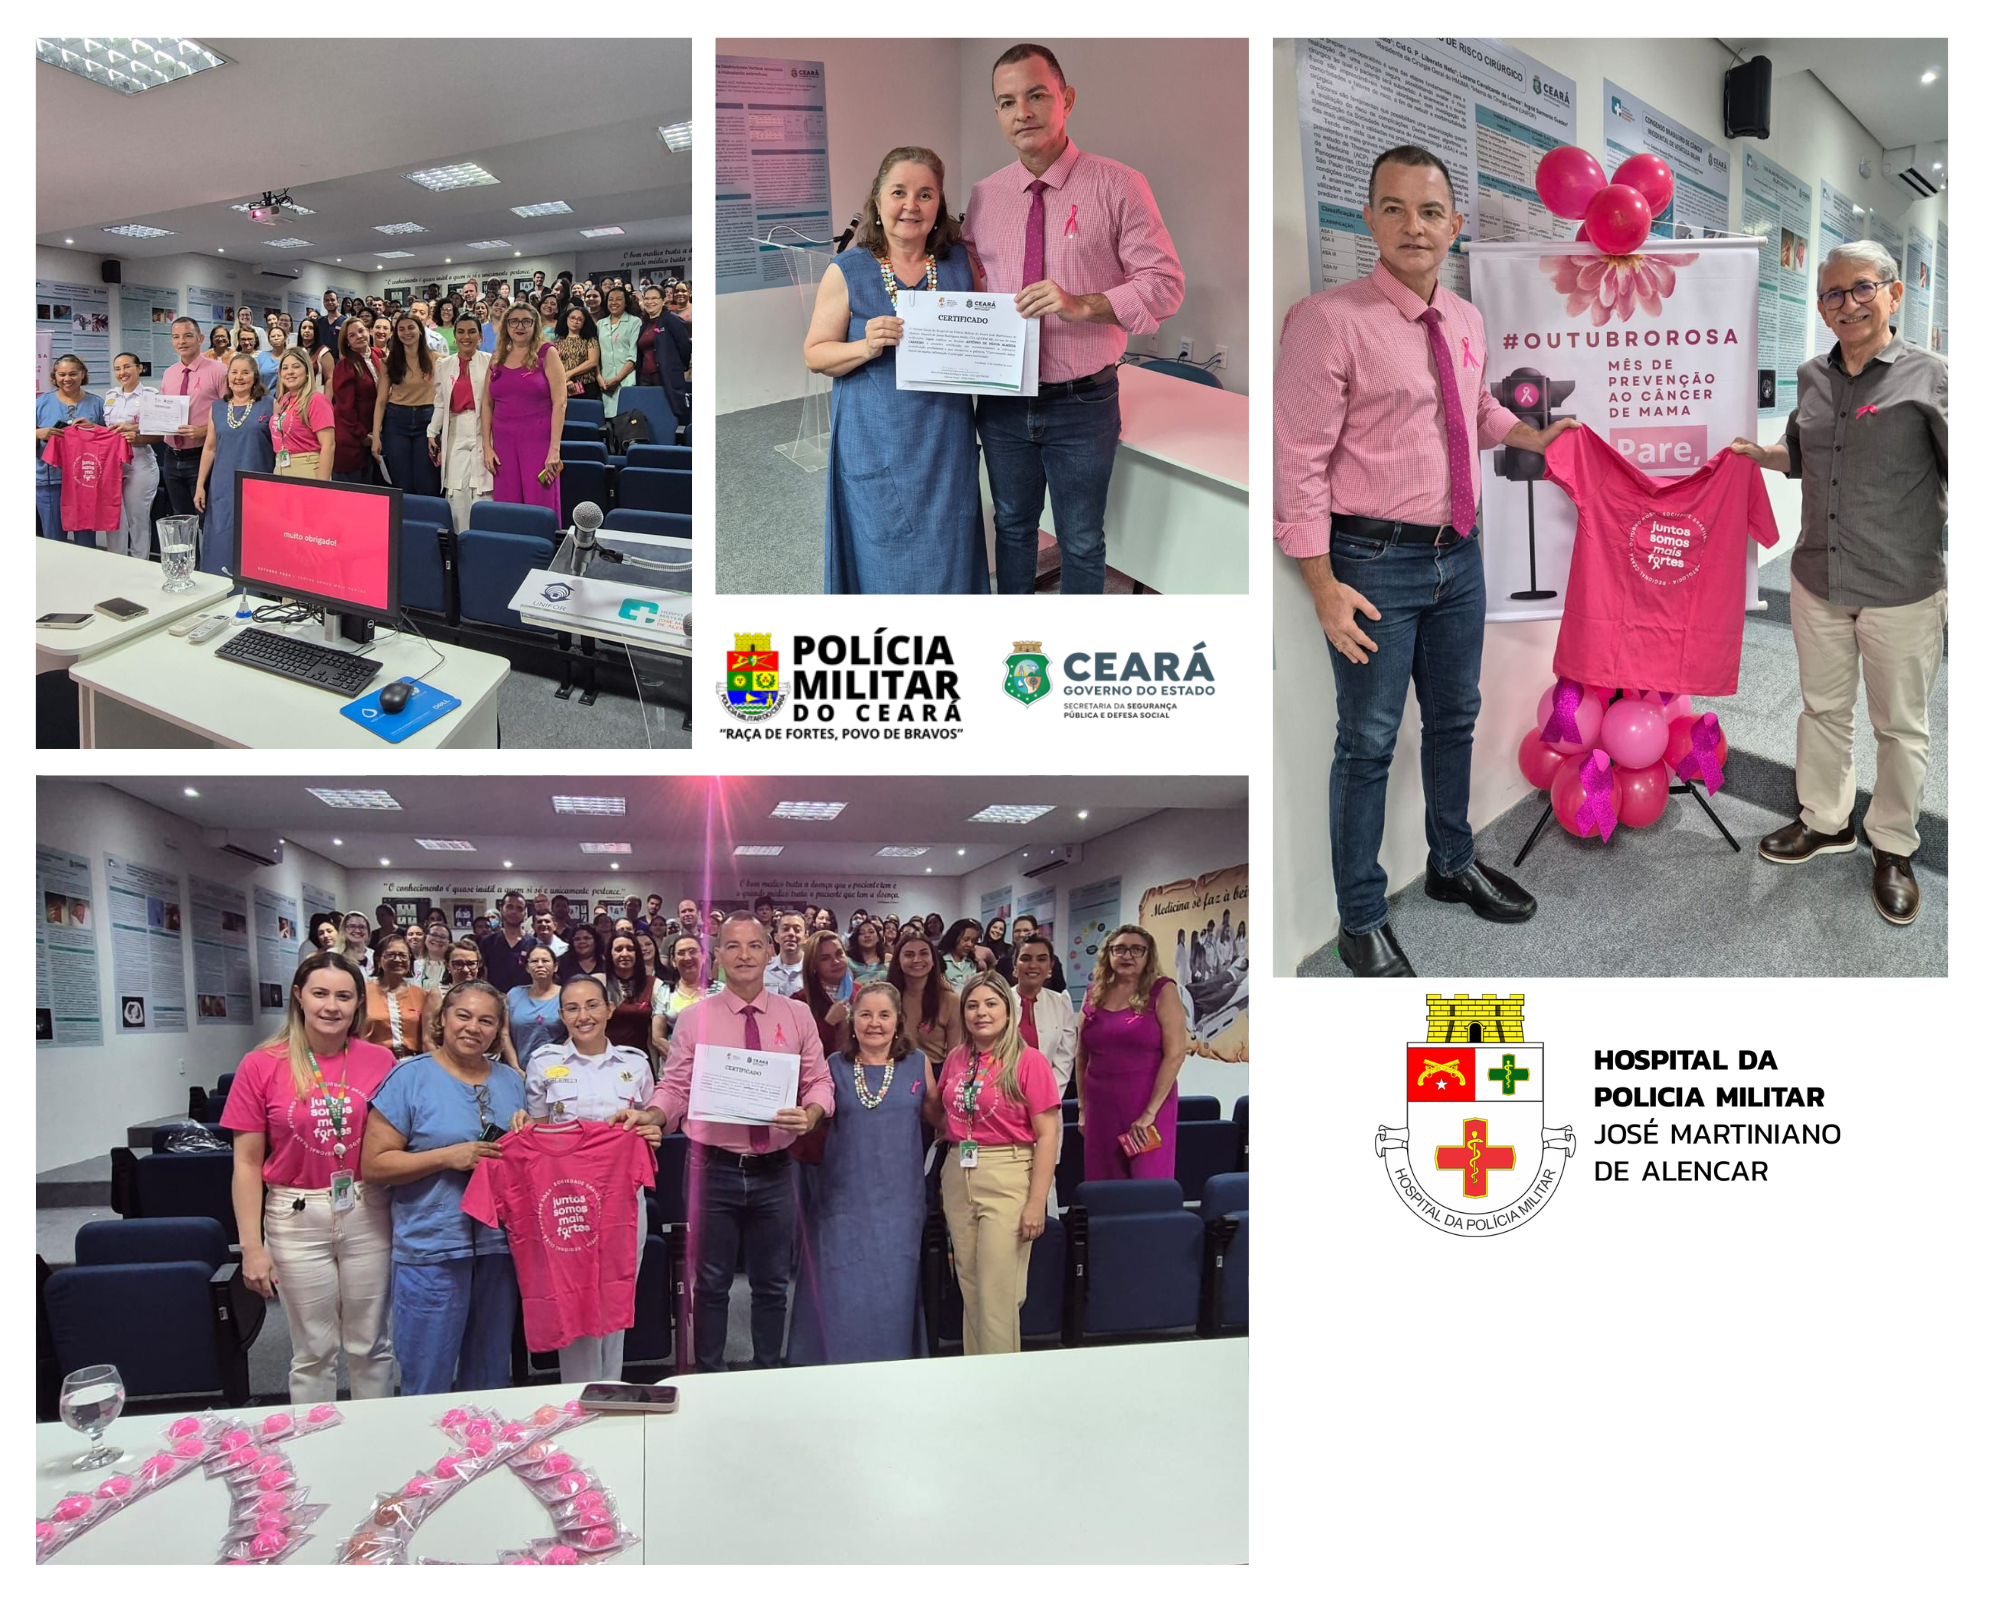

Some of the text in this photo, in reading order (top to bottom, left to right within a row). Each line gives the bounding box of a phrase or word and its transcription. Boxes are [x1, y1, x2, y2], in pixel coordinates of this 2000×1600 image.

[1459, 42, 1483, 62] RISCO
[1484, 56, 1523, 82] CIRÚRGICO
[1543, 83, 1570, 105] CEARÁ
[1645, 116, 1665, 132] CONSENSO
[938, 315, 989, 325] CERTIFICADO
[1503, 328, 1738, 350] #OUTUBROROSA
[1608, 358, 1673, 371] MÊS DE
[1608, 372, 1716, 388] PREVENÇÃO
[1609, 386, 1713, 403] AO CÂNCER
[1609, 405, 1691, 418] DE MAMA
[1617, 438, 1701, 466] Pare,
[1650, 521, 1691, 537] juntos
[284, 532, 337, 547] muito obrigado!
[1650, 534, 1690, 548] somos
[1653, 546, 1682, 557] mais
[1647, 553, 1684, 570] fortes
[532, 601, 566, 612] UNIFOR
[432, 699, 451, 710] DELL
[396, 882, 444, 892] conhecimento
[452, 885, 474, 895] quase
[810, 880, 833, 890] doença
[853, 880, 879, 890] paciente
[880, 881, 892, 889] tem
[1151, 899, 1190, 916] Medicina
[1203, 893, 1221, 910] faz
[1223, 889, 1230, 903] à
[725, 1065, 762, 1077] CERTIFICADO
[553, 1195, 586, 1209] juntos
[553, 1205, 588, 1217] somos
[558, 1213, 585, 1226] mais
[556, 1224, 591, 1241] fortes
